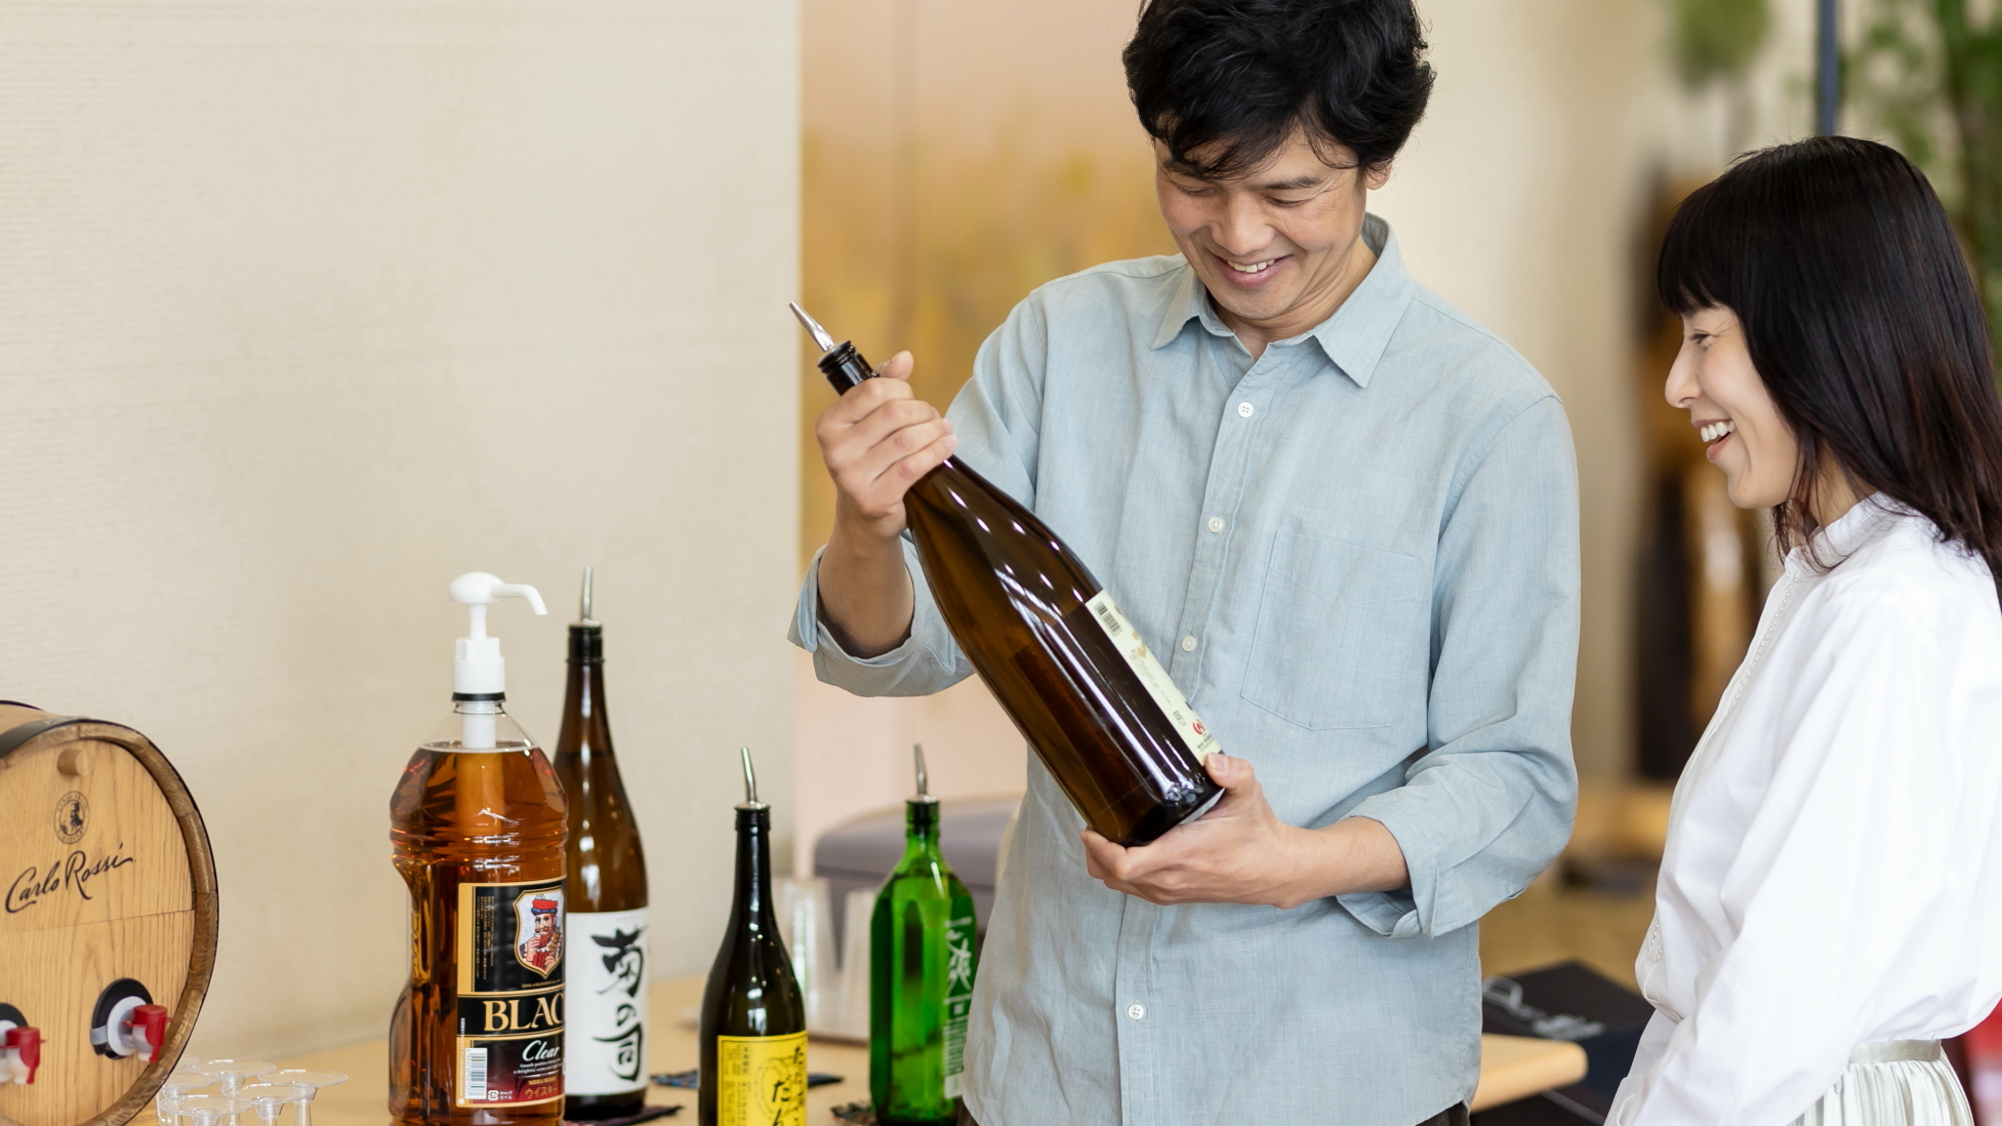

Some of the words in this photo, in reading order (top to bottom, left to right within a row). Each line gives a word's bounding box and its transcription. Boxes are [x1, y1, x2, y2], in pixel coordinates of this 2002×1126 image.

[5, 860, 60, 913] Carlo
[65, 842, 134, 900] Rossi
[522, 1040, 560, 1062] Clear
[525, 1085, 558, 1099] ウイスキー
